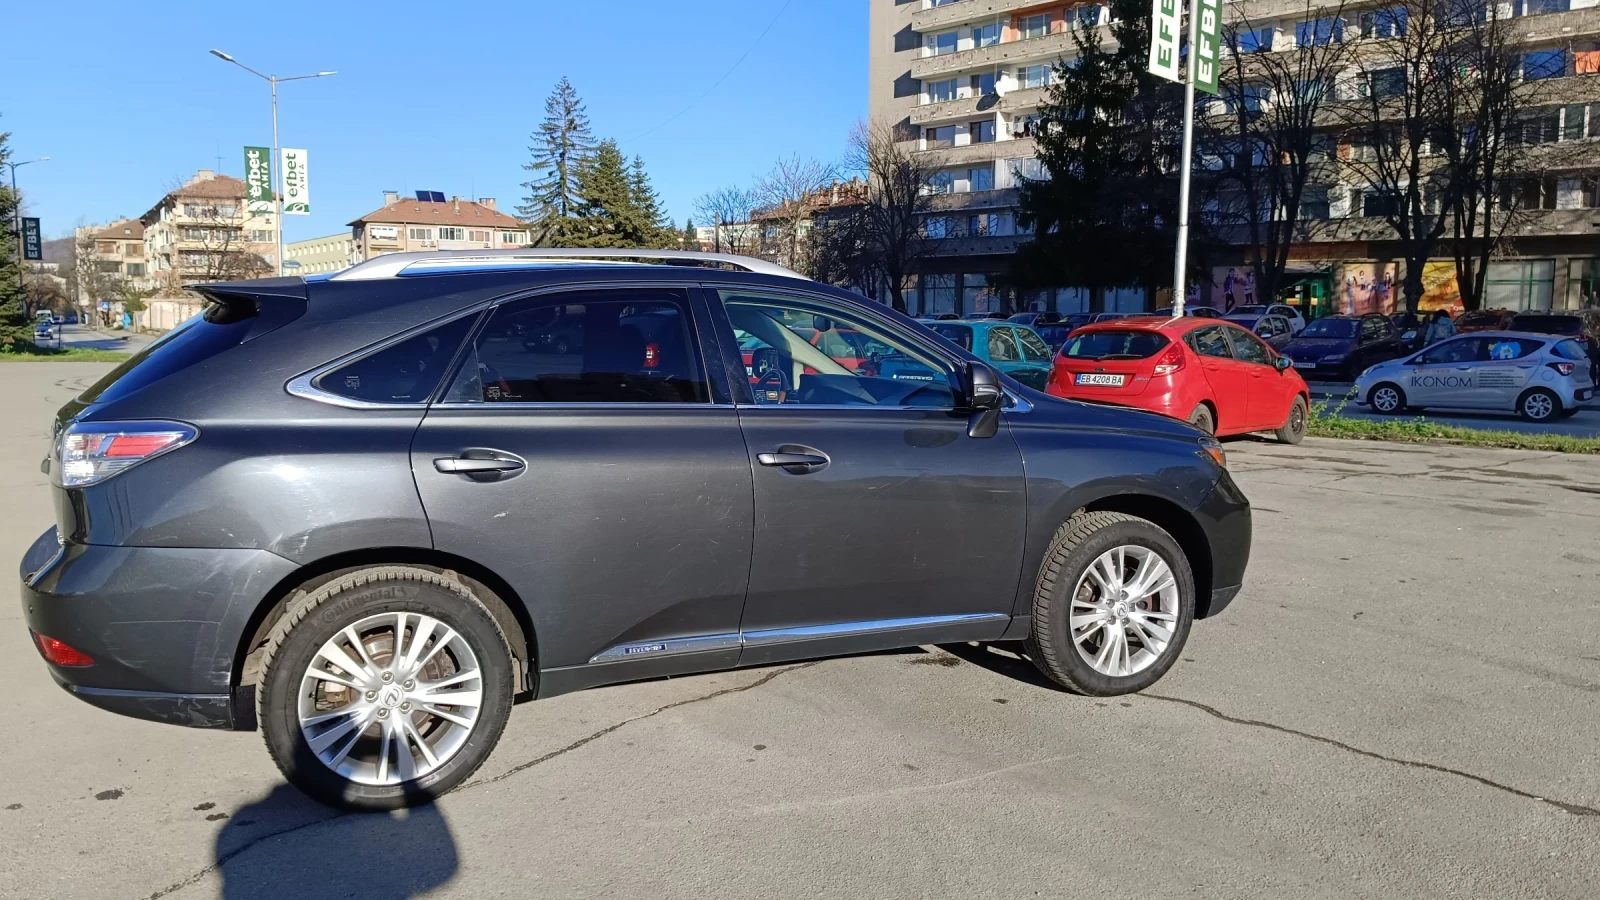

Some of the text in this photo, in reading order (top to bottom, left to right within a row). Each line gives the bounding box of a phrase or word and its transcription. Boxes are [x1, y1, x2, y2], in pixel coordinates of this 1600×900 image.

[247, 150, 262, 198] efbet
[286, 153, 298, 197] efbet
[26, 220, 38, 257] EFBET
[1081, 375, 1122, 384] EB 4208 BA
[1411, 376, 1472, 387] IKONOM
[323, 587, 396, 624] Continental
